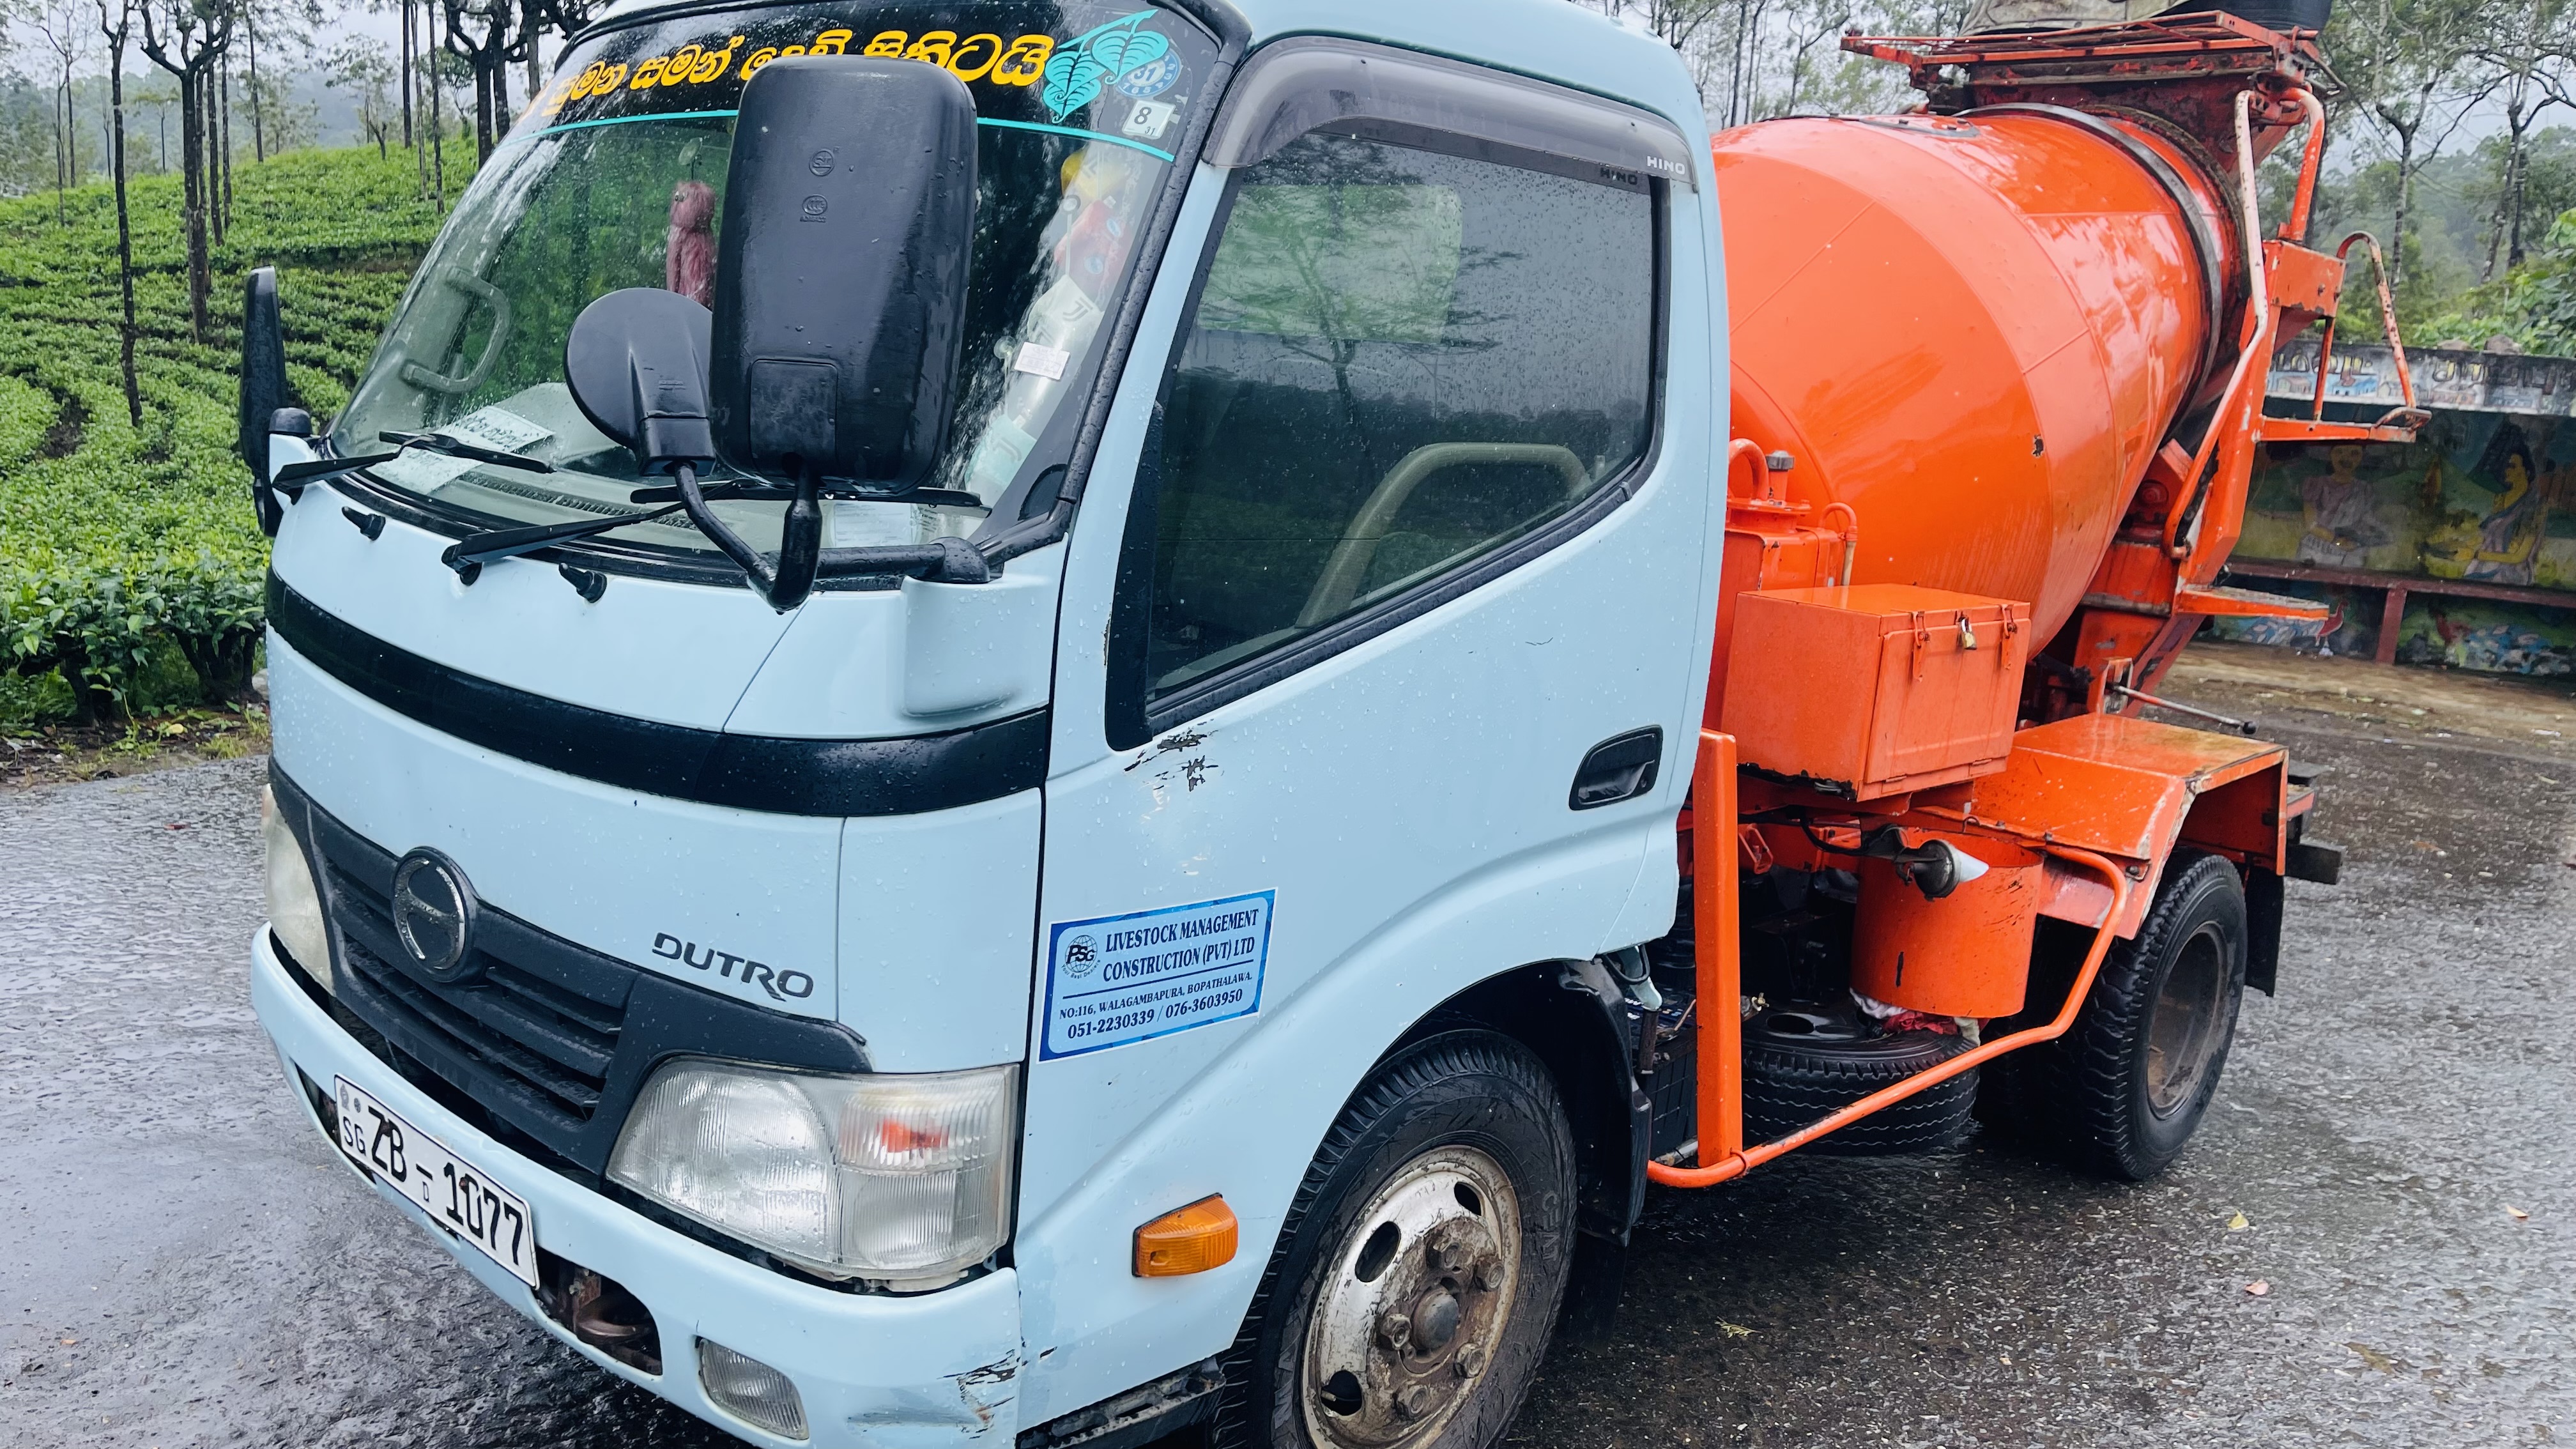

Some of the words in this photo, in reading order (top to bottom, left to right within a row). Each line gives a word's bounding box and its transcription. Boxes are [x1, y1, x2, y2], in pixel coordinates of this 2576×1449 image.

[629, 34, 746, 90] සමන්
[1134, 66, 1158, 82] 31
[1134, 106, 1152, 125] 8
[1144, 126, 1156, 135] 31
[1646, 155, 1685, 175] HINO
[1105, 923, 1177, 953] LIVESTOCK
[1179, 908, 1259, 940] MANAGEMENT
[652, 931, 814, 1002] DUTRO
[1103, 949, 1201, 982] CONSTRUCTION
[1202, 939, 1232, 965] (PVT)
[1233, 936, 1255, 956] LTD
[1059, 1004, 1097, 1020] NO:116,
[1099, 986, 1185, 1013] WALAGAMBAPURA,
[1187, 971, 1253, 994] BOPATHALAWA.
[1068, 1009, 1155, 1039] 051-2230339
[1165, 988, 1243, 1018] 076-3603950
[342, 1116, 367, 1156] SG
[368, 1105, 407, 1183] ZB
[443, 1162, 523, 1266] 1077
